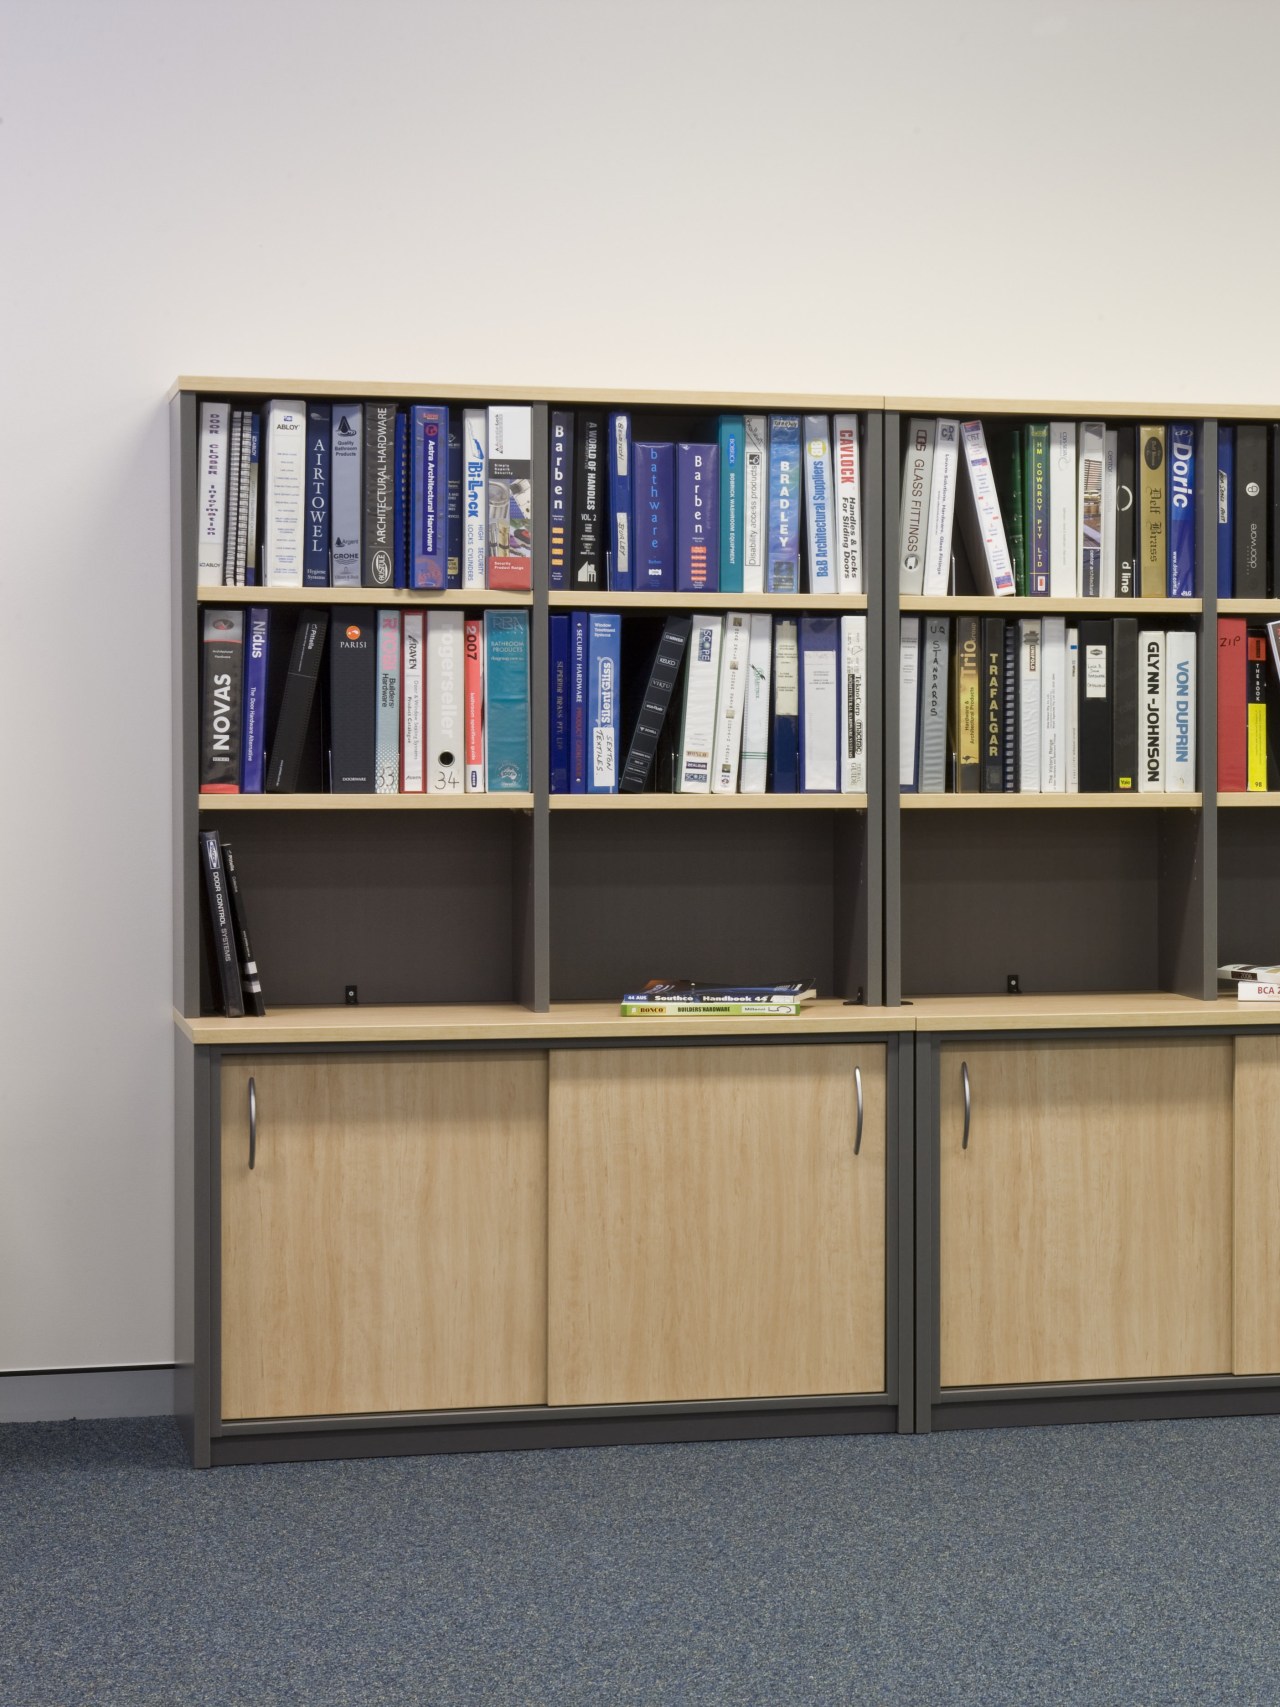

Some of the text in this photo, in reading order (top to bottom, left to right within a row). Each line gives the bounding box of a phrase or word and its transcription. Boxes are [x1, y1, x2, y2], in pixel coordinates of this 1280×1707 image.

[210, 414, 220, 434] DOOR
[1037, 442, 1042, 455] HM
[208, 444, 219, 474] CLOSER
[377, 407, 387, 543] ARCHITECTURAL HARDWARE
[554, 425, 564, 510] Barben
[839, 430, 855, 484] CAVLOCK
[912, 459, 924, 497] GLASS
[1172, 442, 1193, 508] Doric
[310, 439, 326, 552] AIRTOWEL
[427, 462, 435, 513] Architectural
[649, 448, 660, 548] bathware
[694, 455, 702, 533] Barben
[779, 461, 790, 548] BRADLEY
[813, 461, 828, 577] B&B Architectural Suppliers
[842, 515, 850, 549] Sliding
[908, 500, 921, 552] FITTINGS
[1147, 522, 1162, 562] Brass
[1121, 561, 1131, 593] d line
[252, 621, 266, 659] Nidus
[466, 625, 477, 660] 2007
[575, 629, 583, 662] SECURITY
[961, 640, 976, 677] Trio
[1220, 636, 1241, 647] ZIP
[439, 624, 457, 737] rogerseller
[575, 663, 583, 703] HARDWARE
[989, 653, 998, 757] TRAFALGAR
[213, 673, 231, 751] NOVAS
[1175, 661, 1189, 762] VON DUPRIN
[434, 771, 460, 790] 34
[213, 871, 231, 962] DOOR CONTROL SYSTEMS
[1257, 986, 1276, 995] BCA
